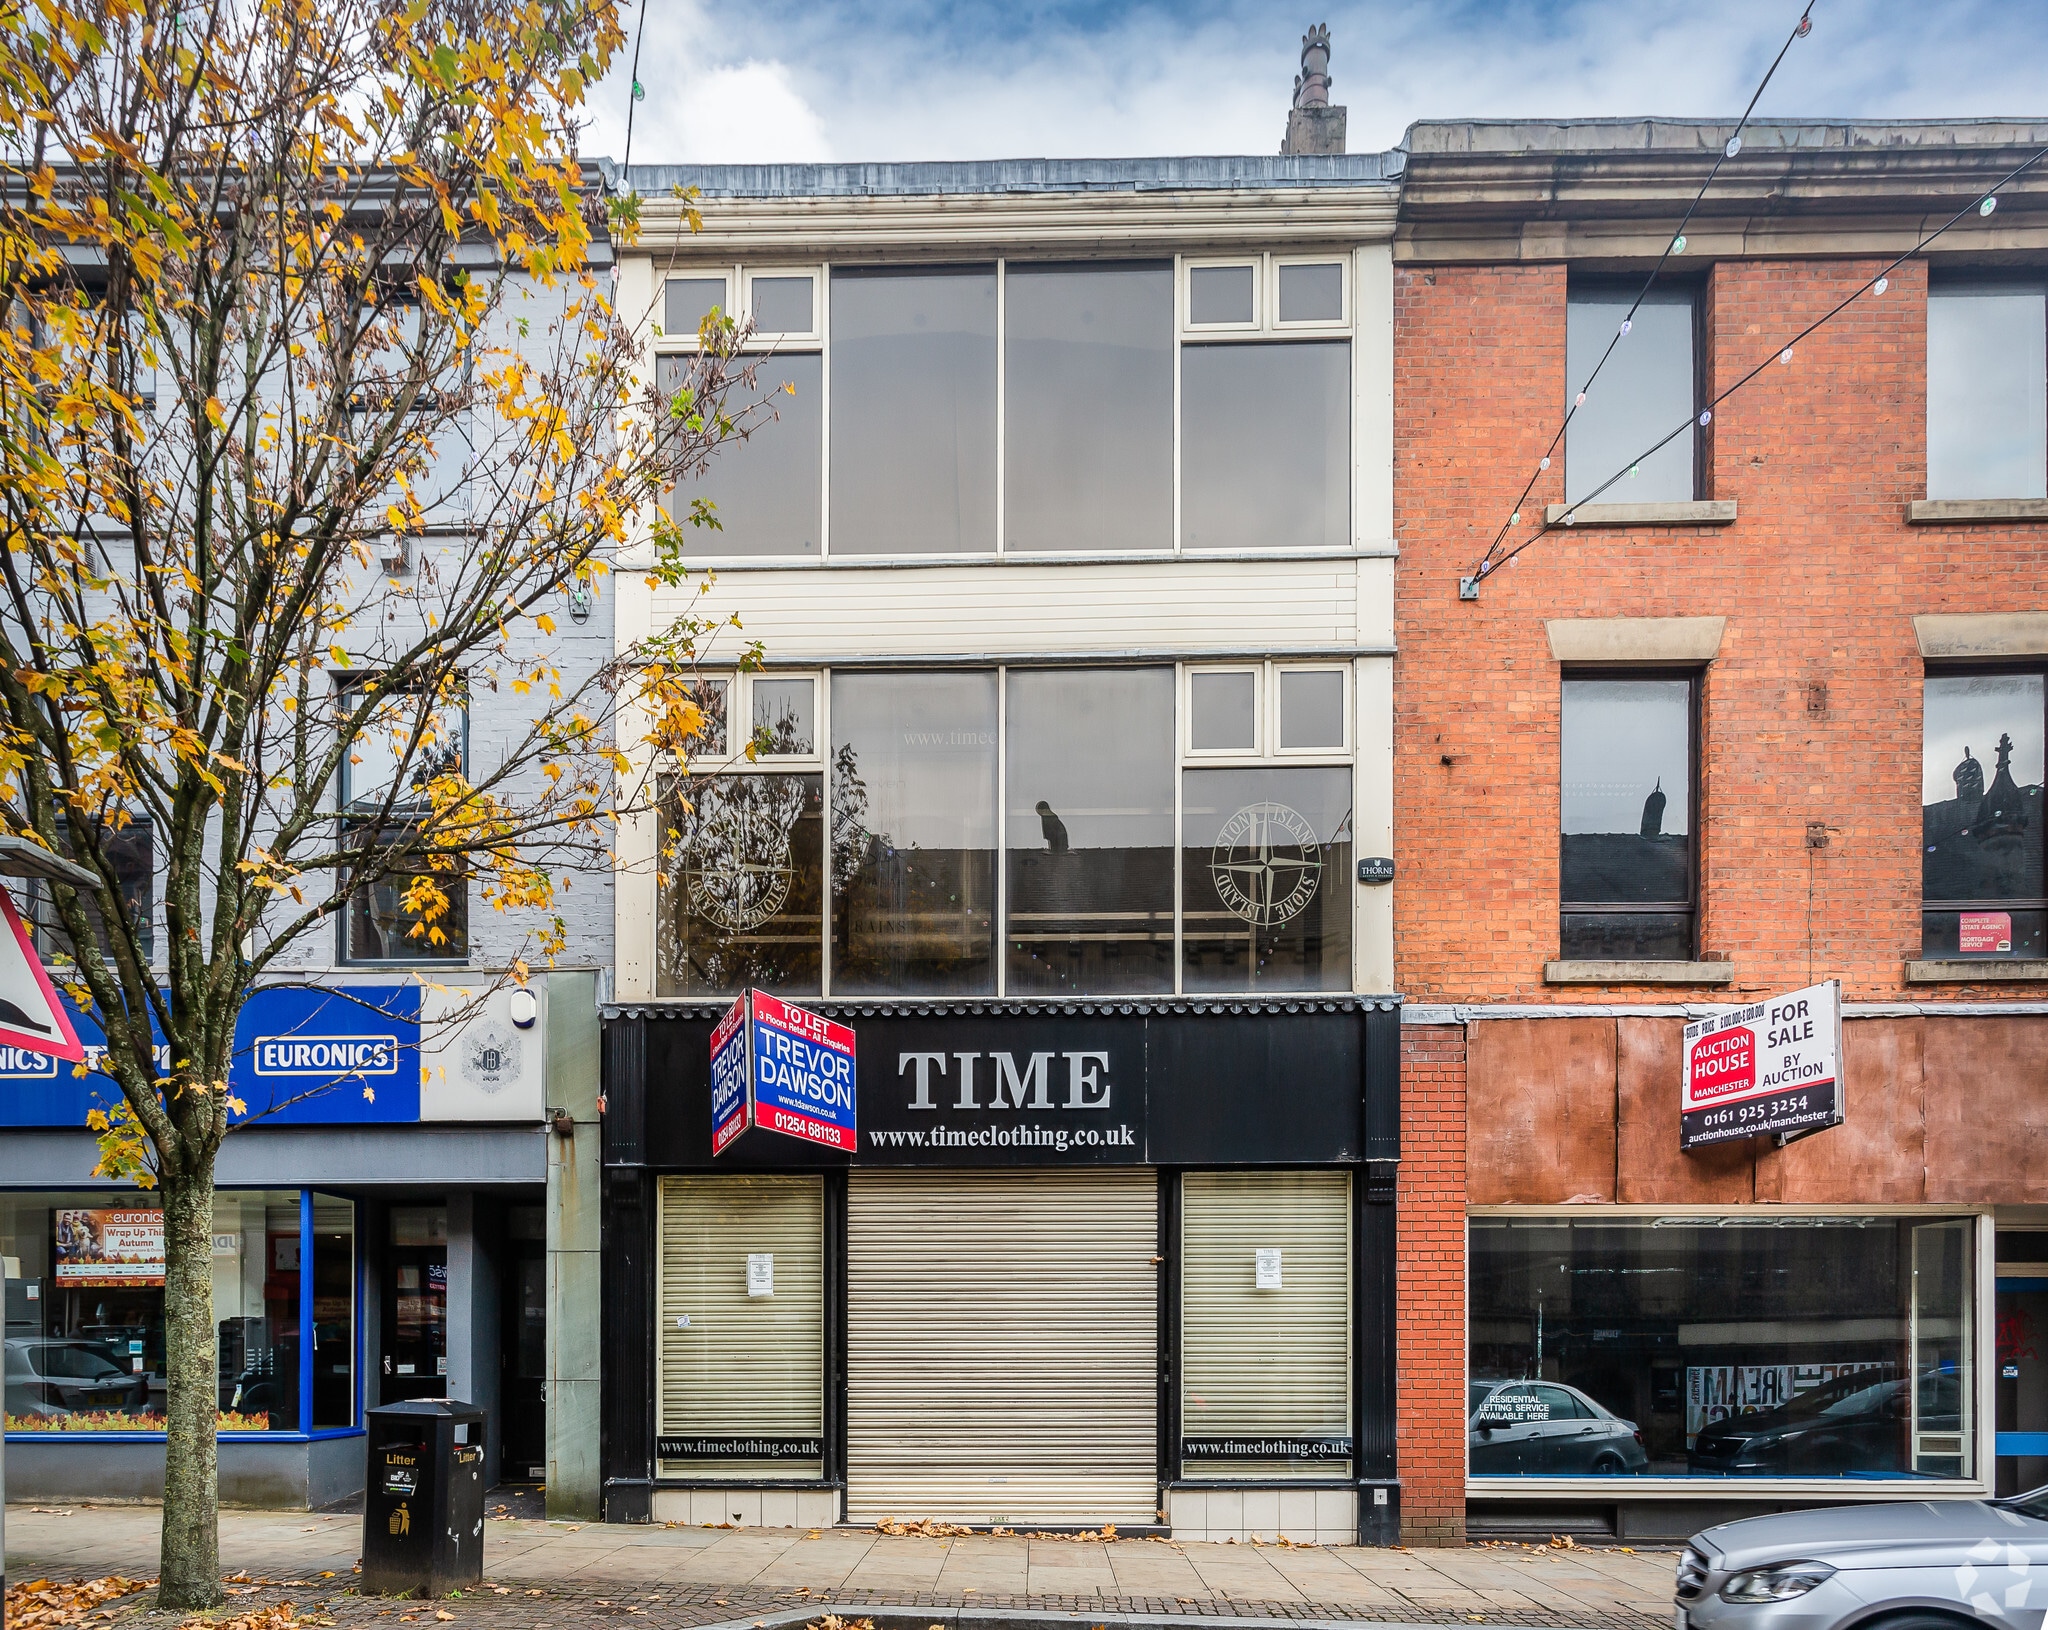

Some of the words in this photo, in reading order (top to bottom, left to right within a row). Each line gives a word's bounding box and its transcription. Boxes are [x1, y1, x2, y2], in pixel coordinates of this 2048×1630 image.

[1273, 806, 1316, 854] ISLAND
[1361, 866, 1393, 875] THORNE
[1217, 874, 1260, 922] ISLAND
[1275, 876, 1315, 921] STONE
[782, 1003, 802, 1024] TO
[804, 1014, 830, 1035] LET
[1770, 999, 1809, 1026] FOR
[759, 1010, 764, 1020] 3
[765, 1013, 787, 1029] Floors
[789, 1022, 807, 1037] Retail
[813, 1032, 821, 1042] All
[822, 1036, 851, 1054] Enquiries
[1686, 1025, 1699, 1039] GUIDE
[1701, 1019, 1715, 1035] PRICE
[1767, 1020, 1814, 1049] SALE
[264, 1043, 389, 1067] EURONICS
[712, 1030, 744, 1087] TREVOR
[759, 1026, 850, 1084] TREVOR
[1694, 1033, 1750, 1060] AUCTION
[1695, 1051, 1750, 1079] HOUSE
[1762, 1061, 1823, 1087] AUCTION
[1783, 1052, 1801, 1069] BY
[713, 1060, 745, 1114] DAWSON
[760, 1055, 851, 1111] DAWSON
[899, 1051, 1111, 1110] TIME
[1694, 1078, 1750, 1099] MANCHESTER
[777, 1094, 837, 1120] www.tdawson.co.uk
[1704, 1109, 1733, 1126] 0161
[1739, 1103, 1765, 1123] 925
[1770, 1095, 1808, 1117] 3254
[775, 1111, 806, 1135] 01254
[808, 1121, 841, 1144] 681133
[869, 1124, 1135, 1152] www.timeclothing.co.uk
[1688, 1110, 1828, 1143] auctionhouse.co.uk/manchester
[107, 1228, 131, 1238] Wrap
[133, 1228, 146, 1238] Up
[118, 1239, 154, 1247] Autumn
[1479, 1404, 1512, 1412] LETTING
[1515, 1404, 1550, 1412] SERVICE
[1489, 1395, 1541, 1404] RESIDENTIAL
[1479, 1412, 1524, 1420] AVAILABLE
[1527, 1412, 1549, 1420] HERE
[386, 1453, 416, 1465] Litter
[460, 1452, 477, 1463] Litter
[661, 1440, 819, 1456] www.timeclothing.co.uk
[1187, 1440, 1349, 1457] www.timeclothing.co.uk
